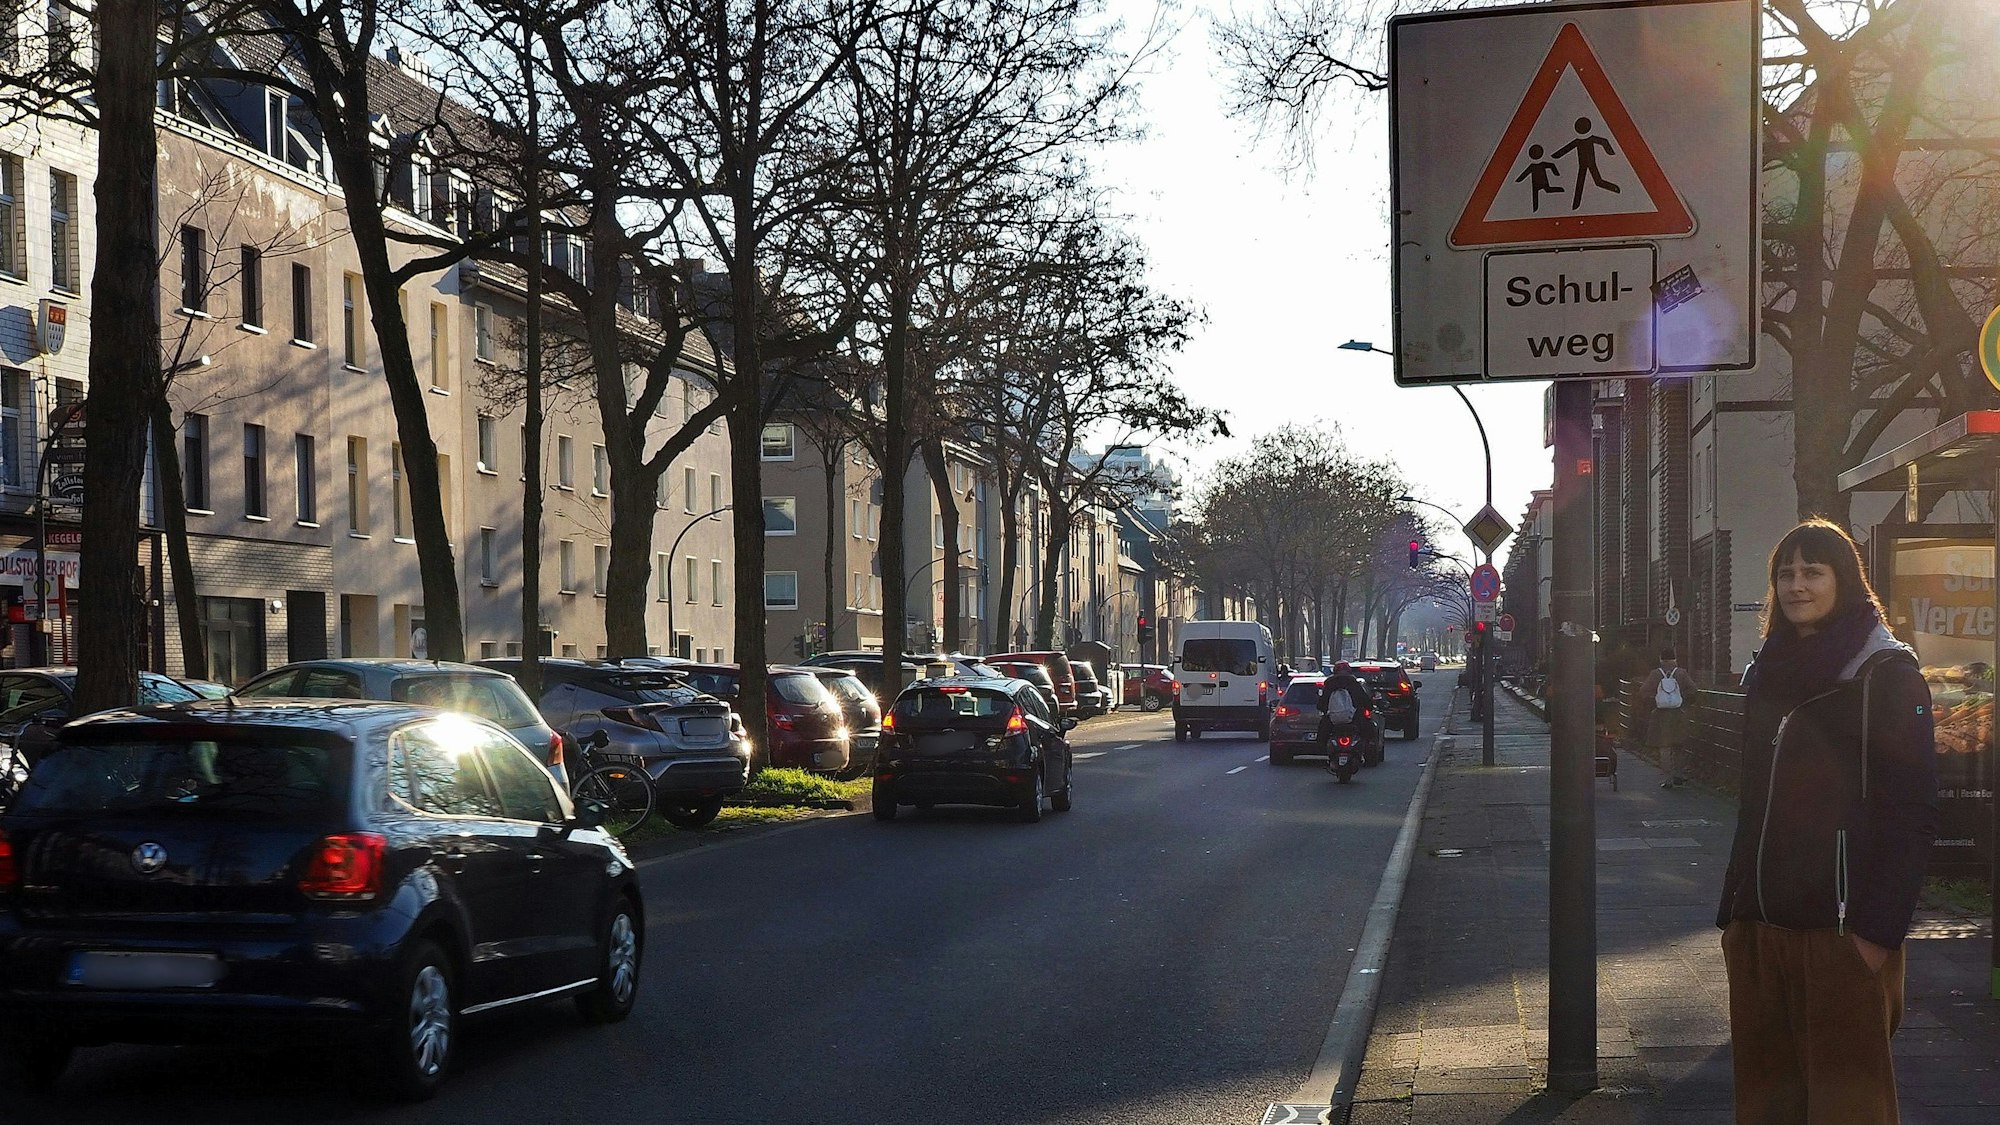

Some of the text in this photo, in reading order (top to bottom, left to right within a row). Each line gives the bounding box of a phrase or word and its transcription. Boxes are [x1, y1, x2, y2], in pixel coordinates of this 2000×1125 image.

[1506, 271, 1633, 307] Schul-
[1527, 333, 1614, 363] weg
[60, 559, 78, 578] HOF
[1911, 597, 1995, 635] Verze
